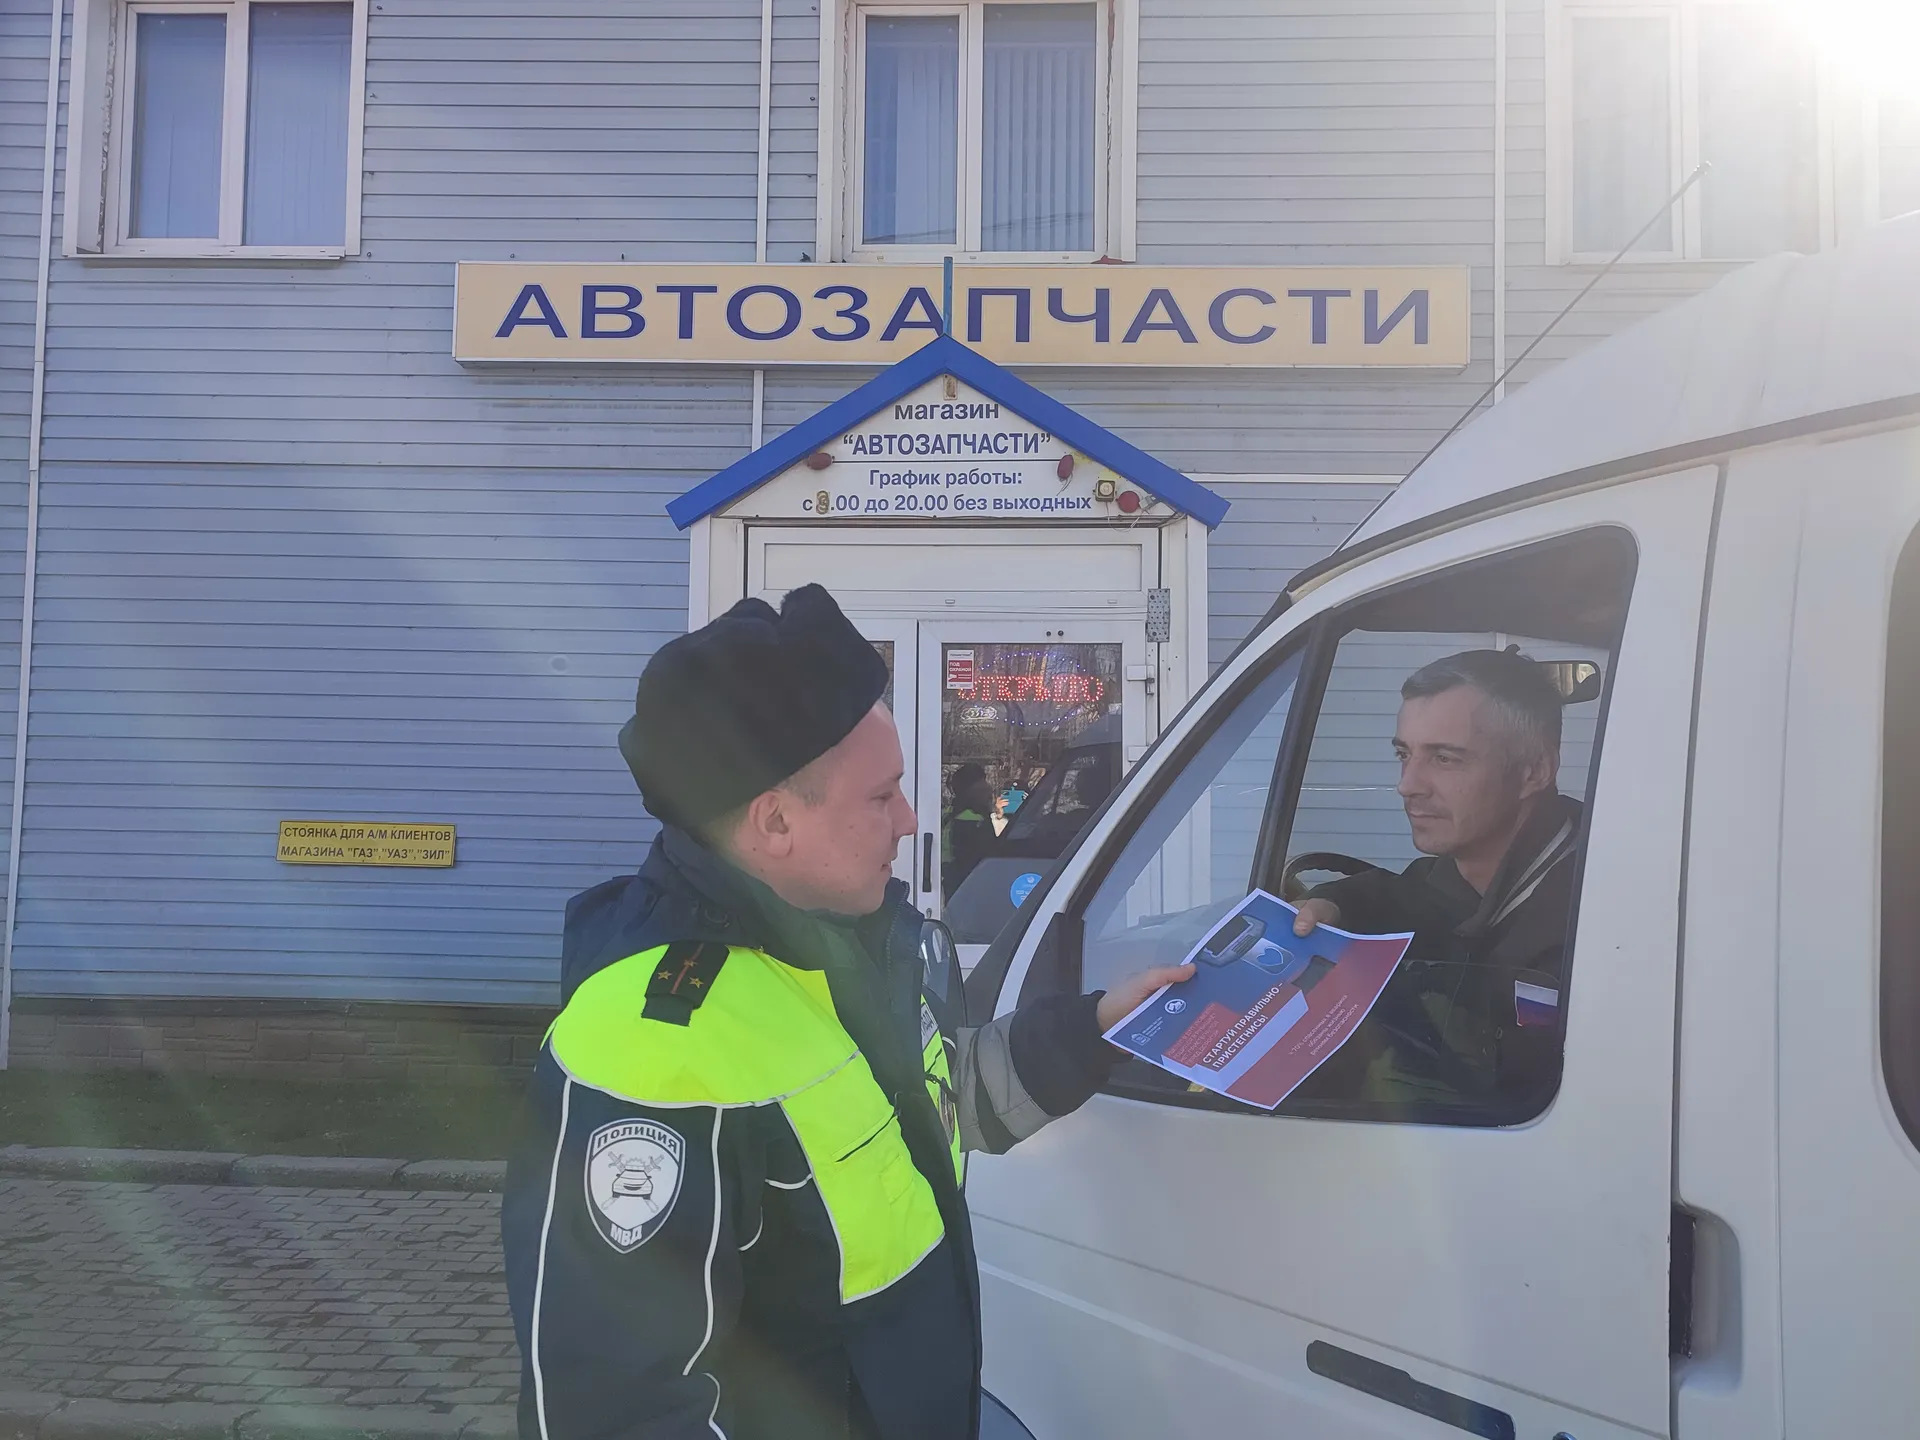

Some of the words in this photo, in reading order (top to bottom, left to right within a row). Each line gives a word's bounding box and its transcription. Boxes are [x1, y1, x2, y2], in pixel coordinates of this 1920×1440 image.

[494, 283, 1429, 345] АВТОЗАПЧАСТИ
[894, 403, 999, 420] магазин
[869, 469, 941, 488] График
[945, 468, 1023, 487] работы:
[802, 499, 813, 511] с
[864, 499, 890, 512] до
[894, 495, 949, 511] 20.00
[953, 493, 988, 511] без
[993, 496, 1092, 512] выходных
[284, 827, 337, 838] СТОЯНКА
[340, 828, 364, 840] ДЛЯ
[367, 829, 387, 839] А/М
[390, 830, 451, 841] КЛИЕНТОВ
[280, 846, 344, 857] МАГАЗИНА
[1202, 1028, 1237, 1063] СТАРТУЙ
[1234, 987, 1280, 1030] ПРАВИЛЬНО
[1212, 1014, 1268, 1068] ПРИСТЕГНИСЬ!
[597, 1126, 678, 1155] ПОЛИЦИЯ
[610, 1222, 643, 1247] МВД
